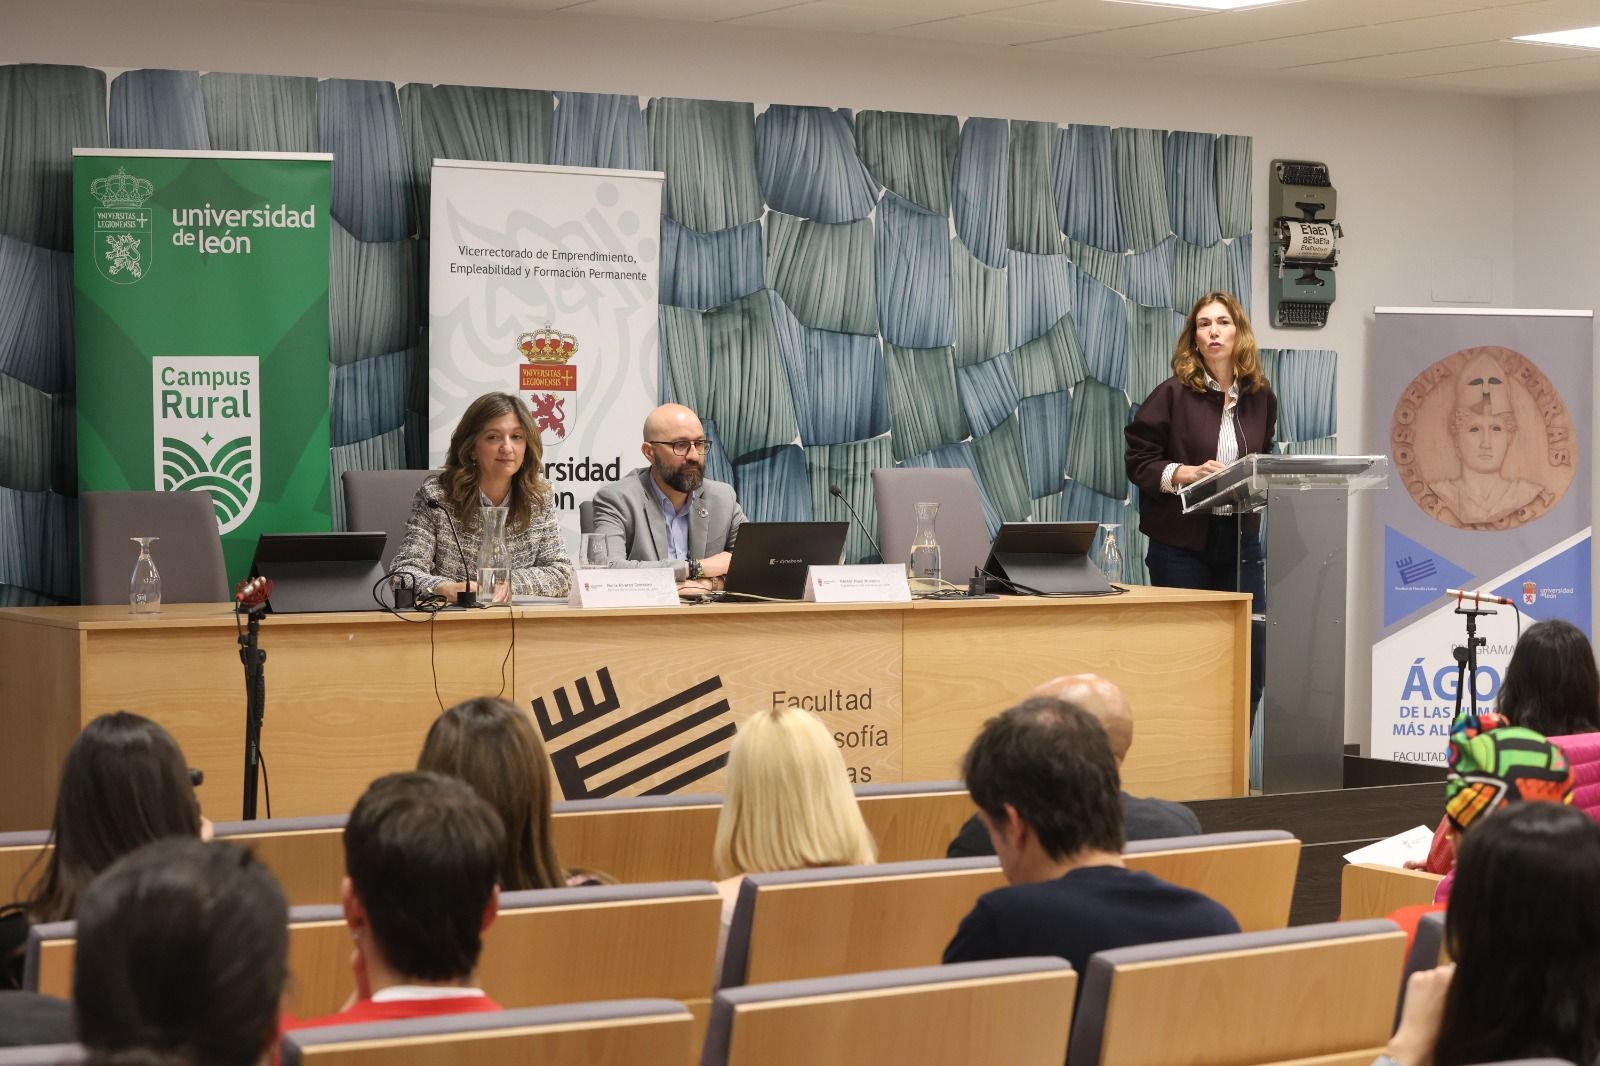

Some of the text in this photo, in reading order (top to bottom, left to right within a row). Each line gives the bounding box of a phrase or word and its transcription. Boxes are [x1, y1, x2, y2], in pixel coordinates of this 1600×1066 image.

[172, 203, 315, 229] universidad
[172, 229, 251, 254] de león
[458, 245, 637, 264] Vicerrectorado de Emprendimiento,
[450, 262, 647, 280] Empleabilidad y Formación Permanente
[161, 366, 251, 390] Campus
[161, 389, 251, 419] Rural
[545, 456, 620, 482] rsidad
[1401, 657, 1508, 702] ÁGO
[772, 688, 872, 712] Facultad
[1400, 706, 1419, 719] DE
[1423, 706, 1451, 719] LAS
[833, 724, 888, 749] sofía
[1393, 721, 1425, 736] MÁS
[1393, 751, 1447, 763] FACULTAD
